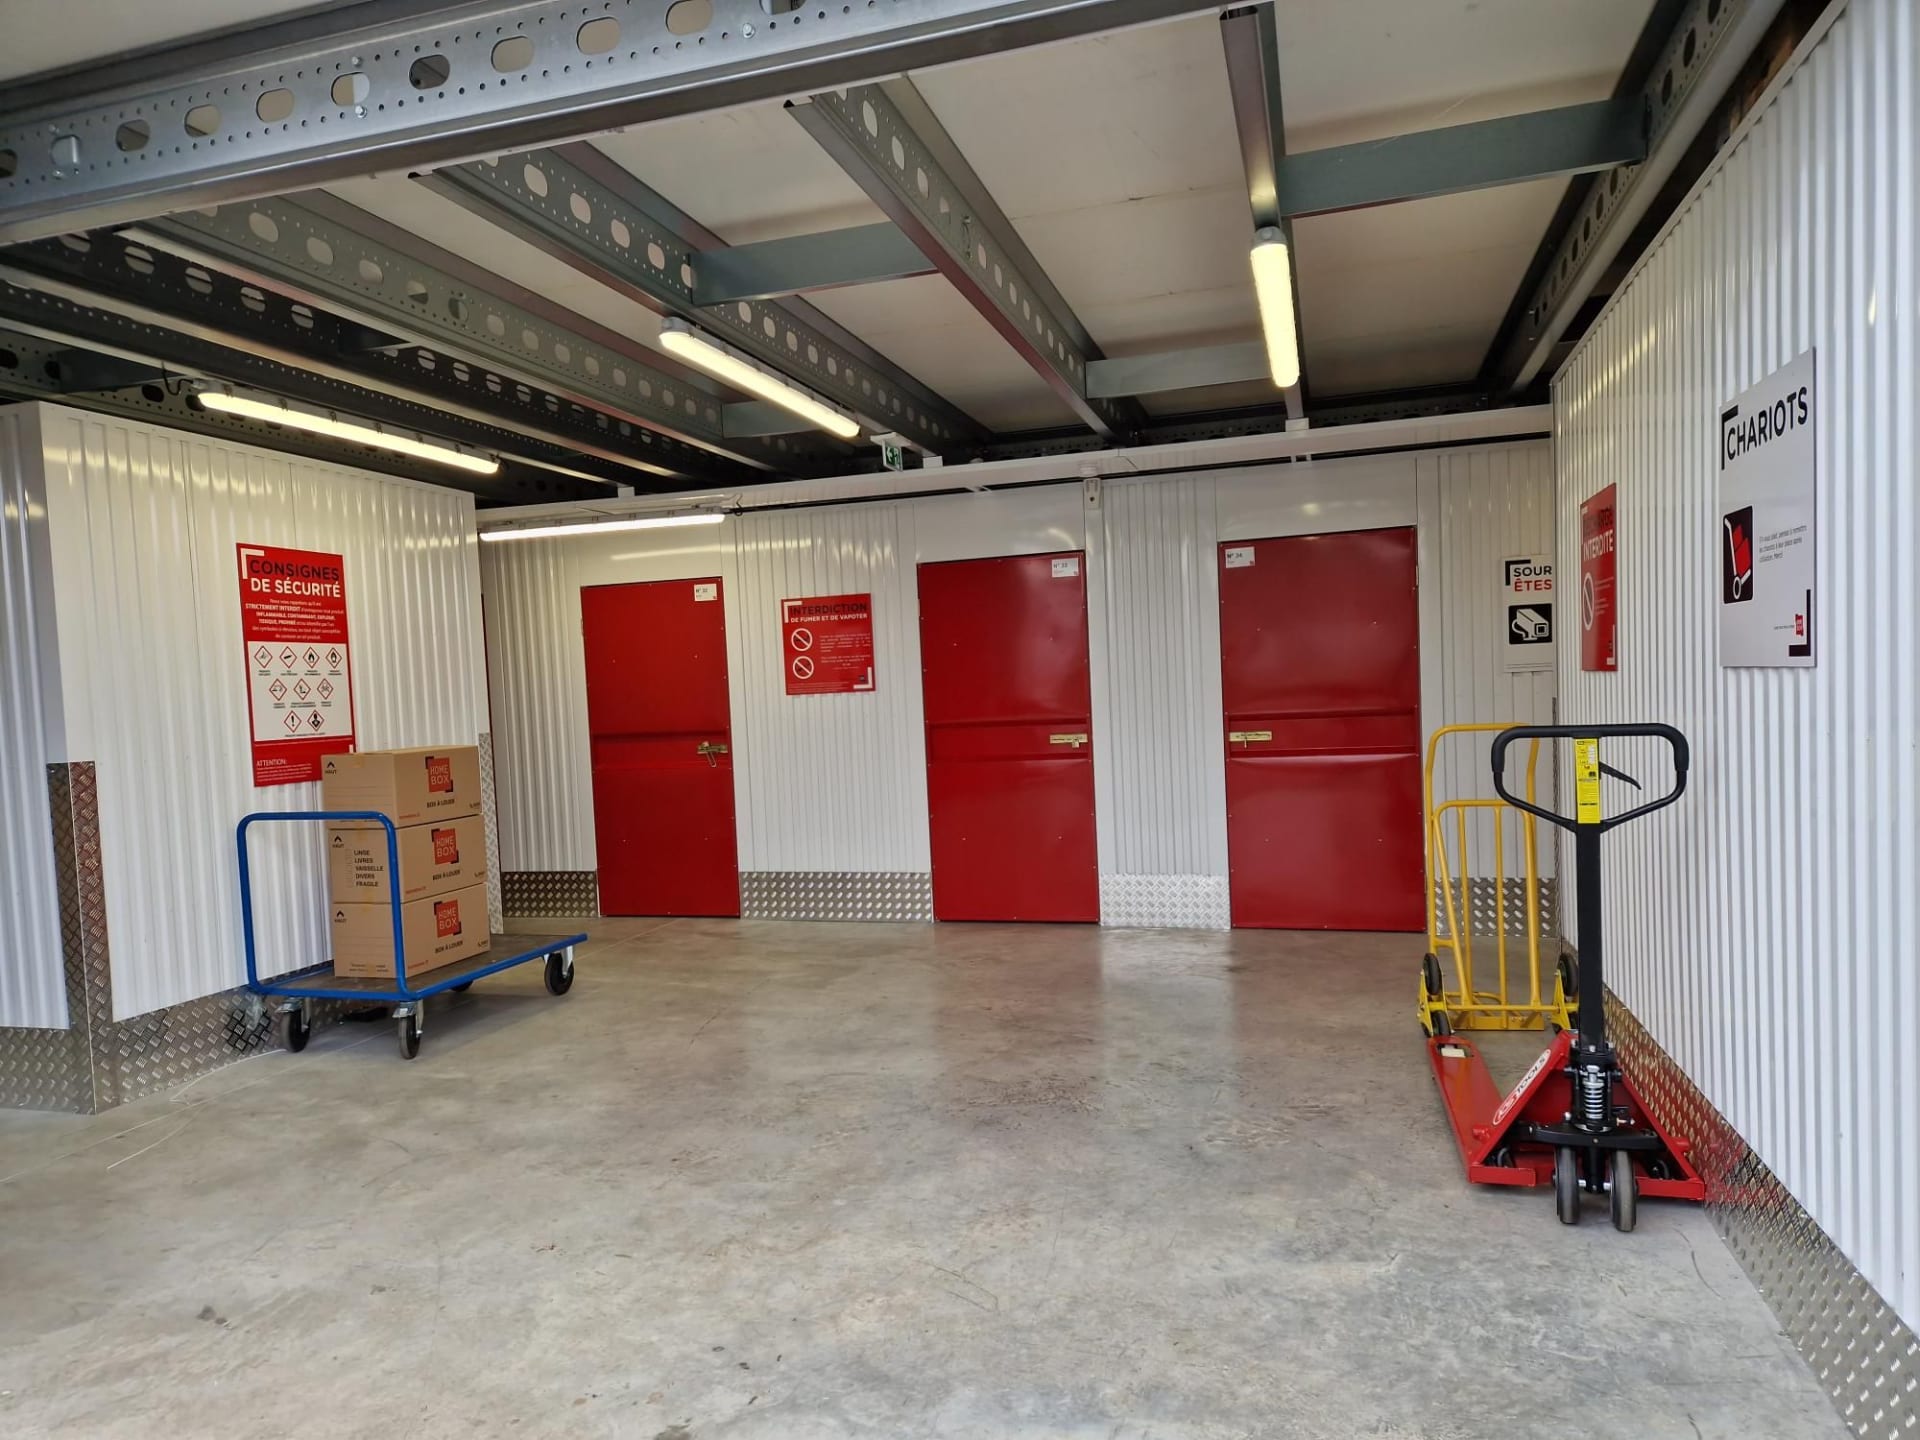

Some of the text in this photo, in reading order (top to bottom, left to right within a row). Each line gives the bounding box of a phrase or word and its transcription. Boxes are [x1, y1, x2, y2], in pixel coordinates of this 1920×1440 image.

[1727, 386, 1808, 461] CHARIOTS
[1583, 529, 1614, 562] INTERDITE
[250, 559, 339, 581] CONSIGNES
[1513, 565, 1552, 577] SOUR
[251, 577, 341, 598] DE SÉCURITÉ
[1514, 577, 1552, 592] ÊTES
[791, 603, 867, 615] INTERDICTION
[430, 764, 448, 775] HOME
[430, 774, 450, 785] BOX
[436, 835, 454, 848] HOME
[436, 846, 455, 857] BOX
[438, 907, 457, 919] HOME
[439, 917, 458, 930] BOX
